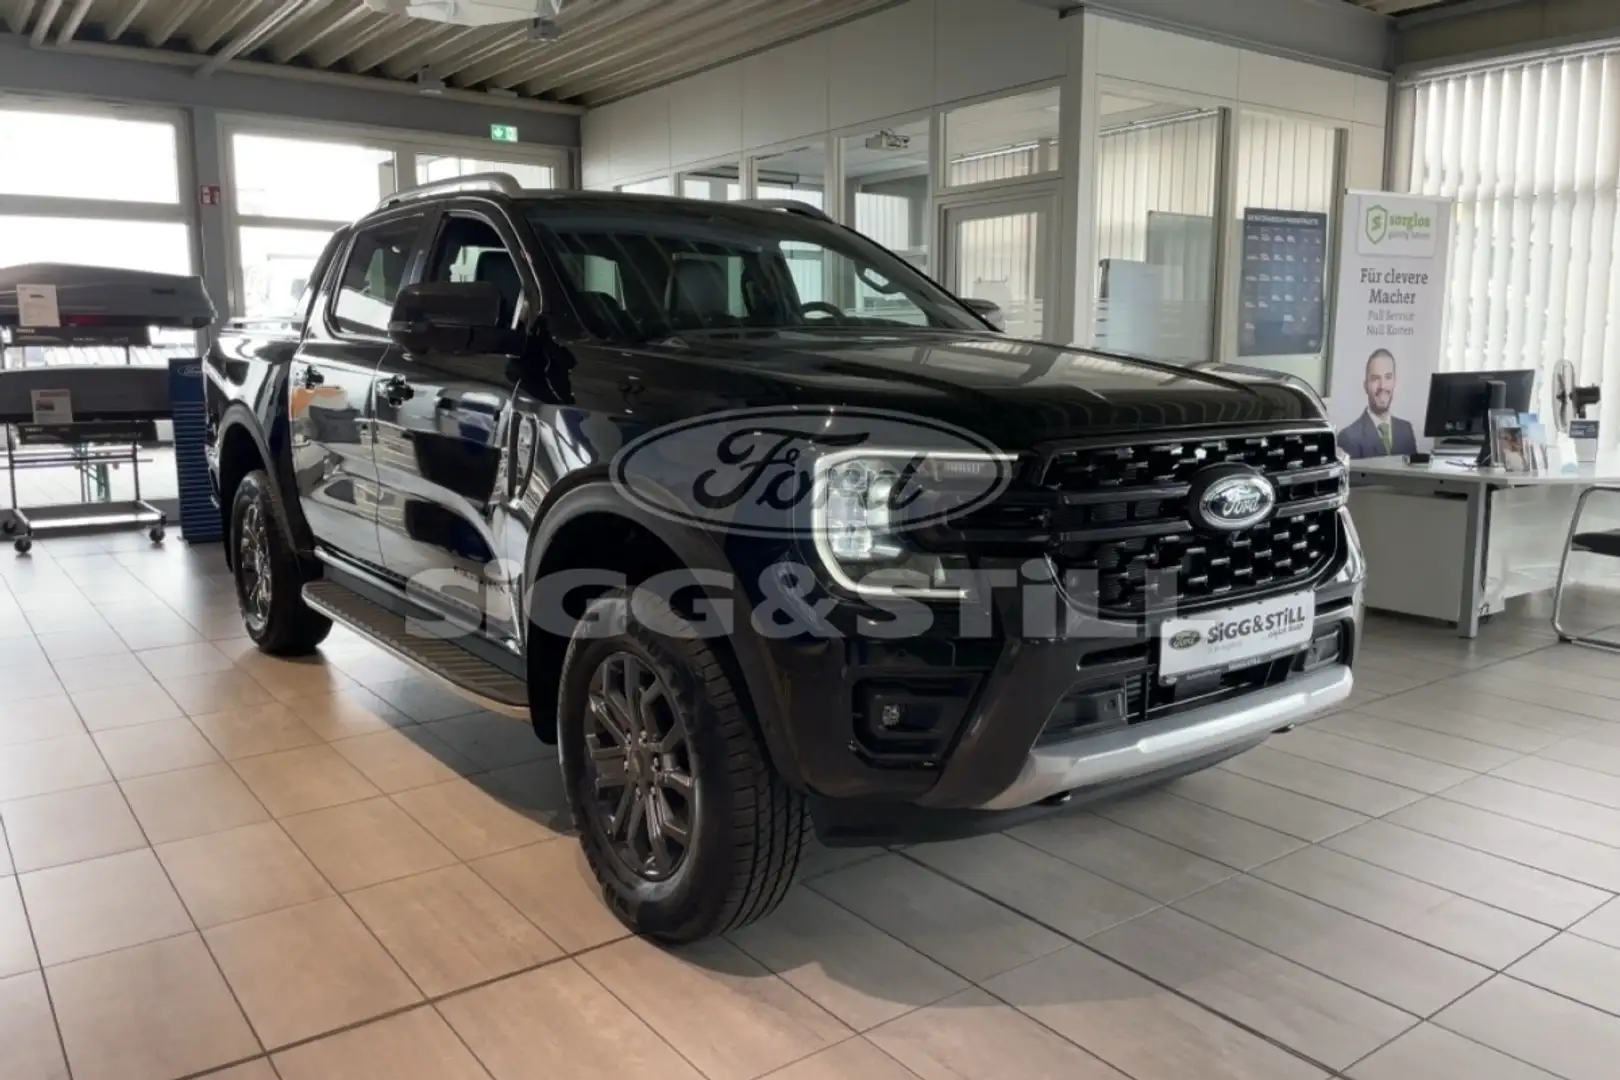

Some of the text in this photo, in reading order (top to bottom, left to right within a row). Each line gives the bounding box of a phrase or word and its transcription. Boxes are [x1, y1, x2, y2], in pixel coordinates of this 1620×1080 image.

[1360, 267, 1429, 285] Für clevere
[1368, 288, 1416, 304] Macher
